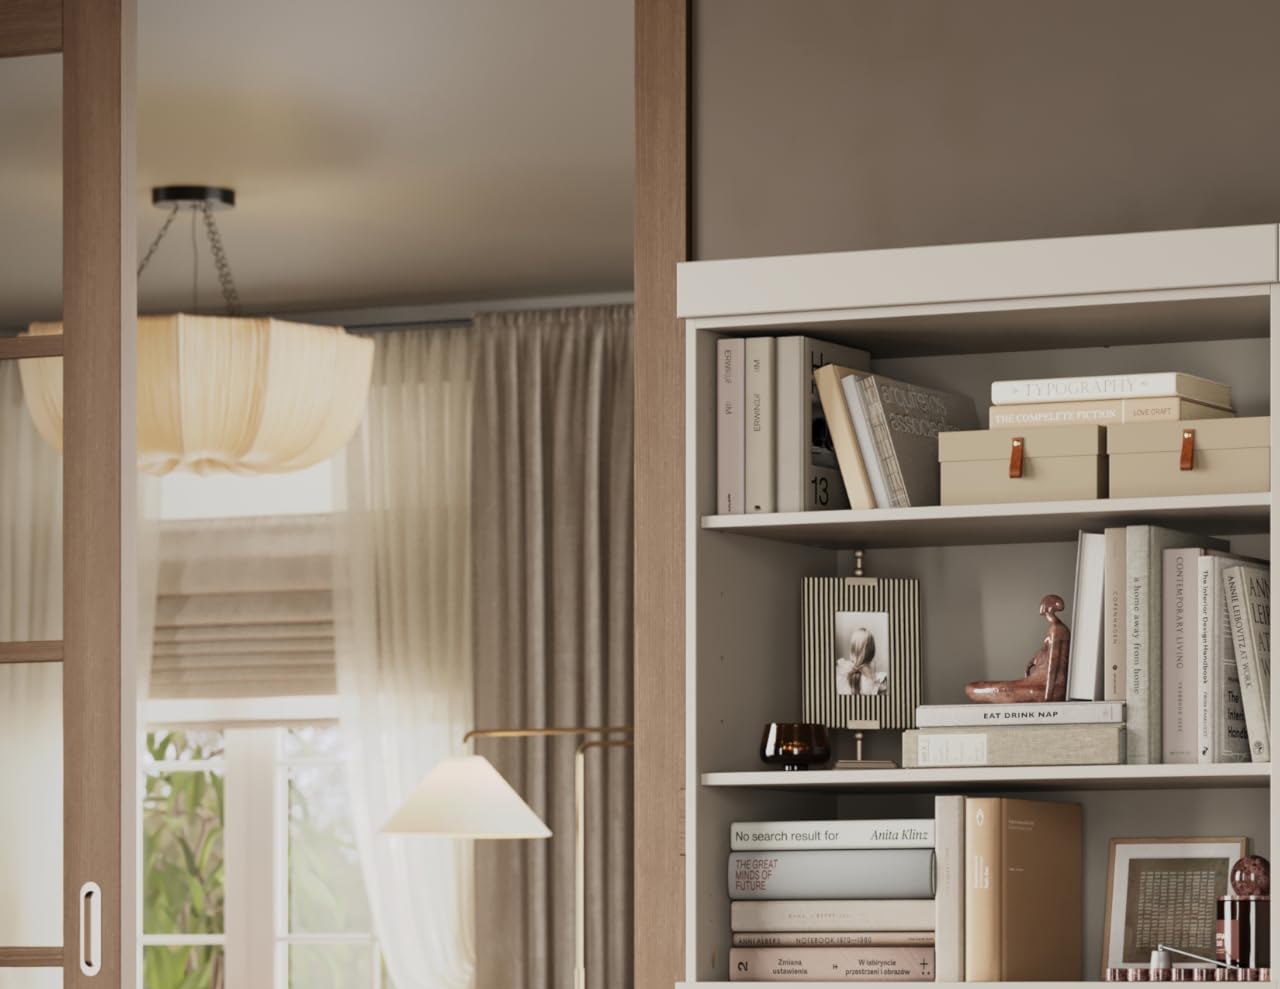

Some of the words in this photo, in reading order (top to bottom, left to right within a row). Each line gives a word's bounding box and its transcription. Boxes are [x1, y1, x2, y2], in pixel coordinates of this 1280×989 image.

[1025, 378, 1134, 397] TYPOGRAPHY
[811, 477, 829, 505] 13
[1201, 570, 1209, 584] The
[1227, 575, 1239, 603] ANNIE
[1134, 585, 1142, 612] home
[1176, 556, 1184, 634] CONTEMPORARY
[1201, 586, 1209, 616] Interior
[1132, 615, 1140, 641] away
[1200, 616, 1209, 644] Design
[1232, 605, 1246, 649] LEIBOVITZ
[1134, 643, 1142, 666] from
[1176, 637, 1184, 670] LIVING
[1201, 645, 1209, 684] Handbook
[1134, 669, 1142, 695] home
[984, 712, 1002, 720] EAT
[735, 831, 750, 842] No
[752, 830, 788, 842] search
[791, 829, 821, 841] result
[824, 829, 840, 841] for
[870, 829, 899, 841] Anita
[902, 828, 929, 841] Klinz
[735, 870, 760, 880] MINDS
[762, 870, 773, 880] OF
[736, 859, 751, 870] THE
[752, 859, 779, 869] GREAT
[735, 881, 767, 891] FUTURE
[738, 962, 748, 972] 2
